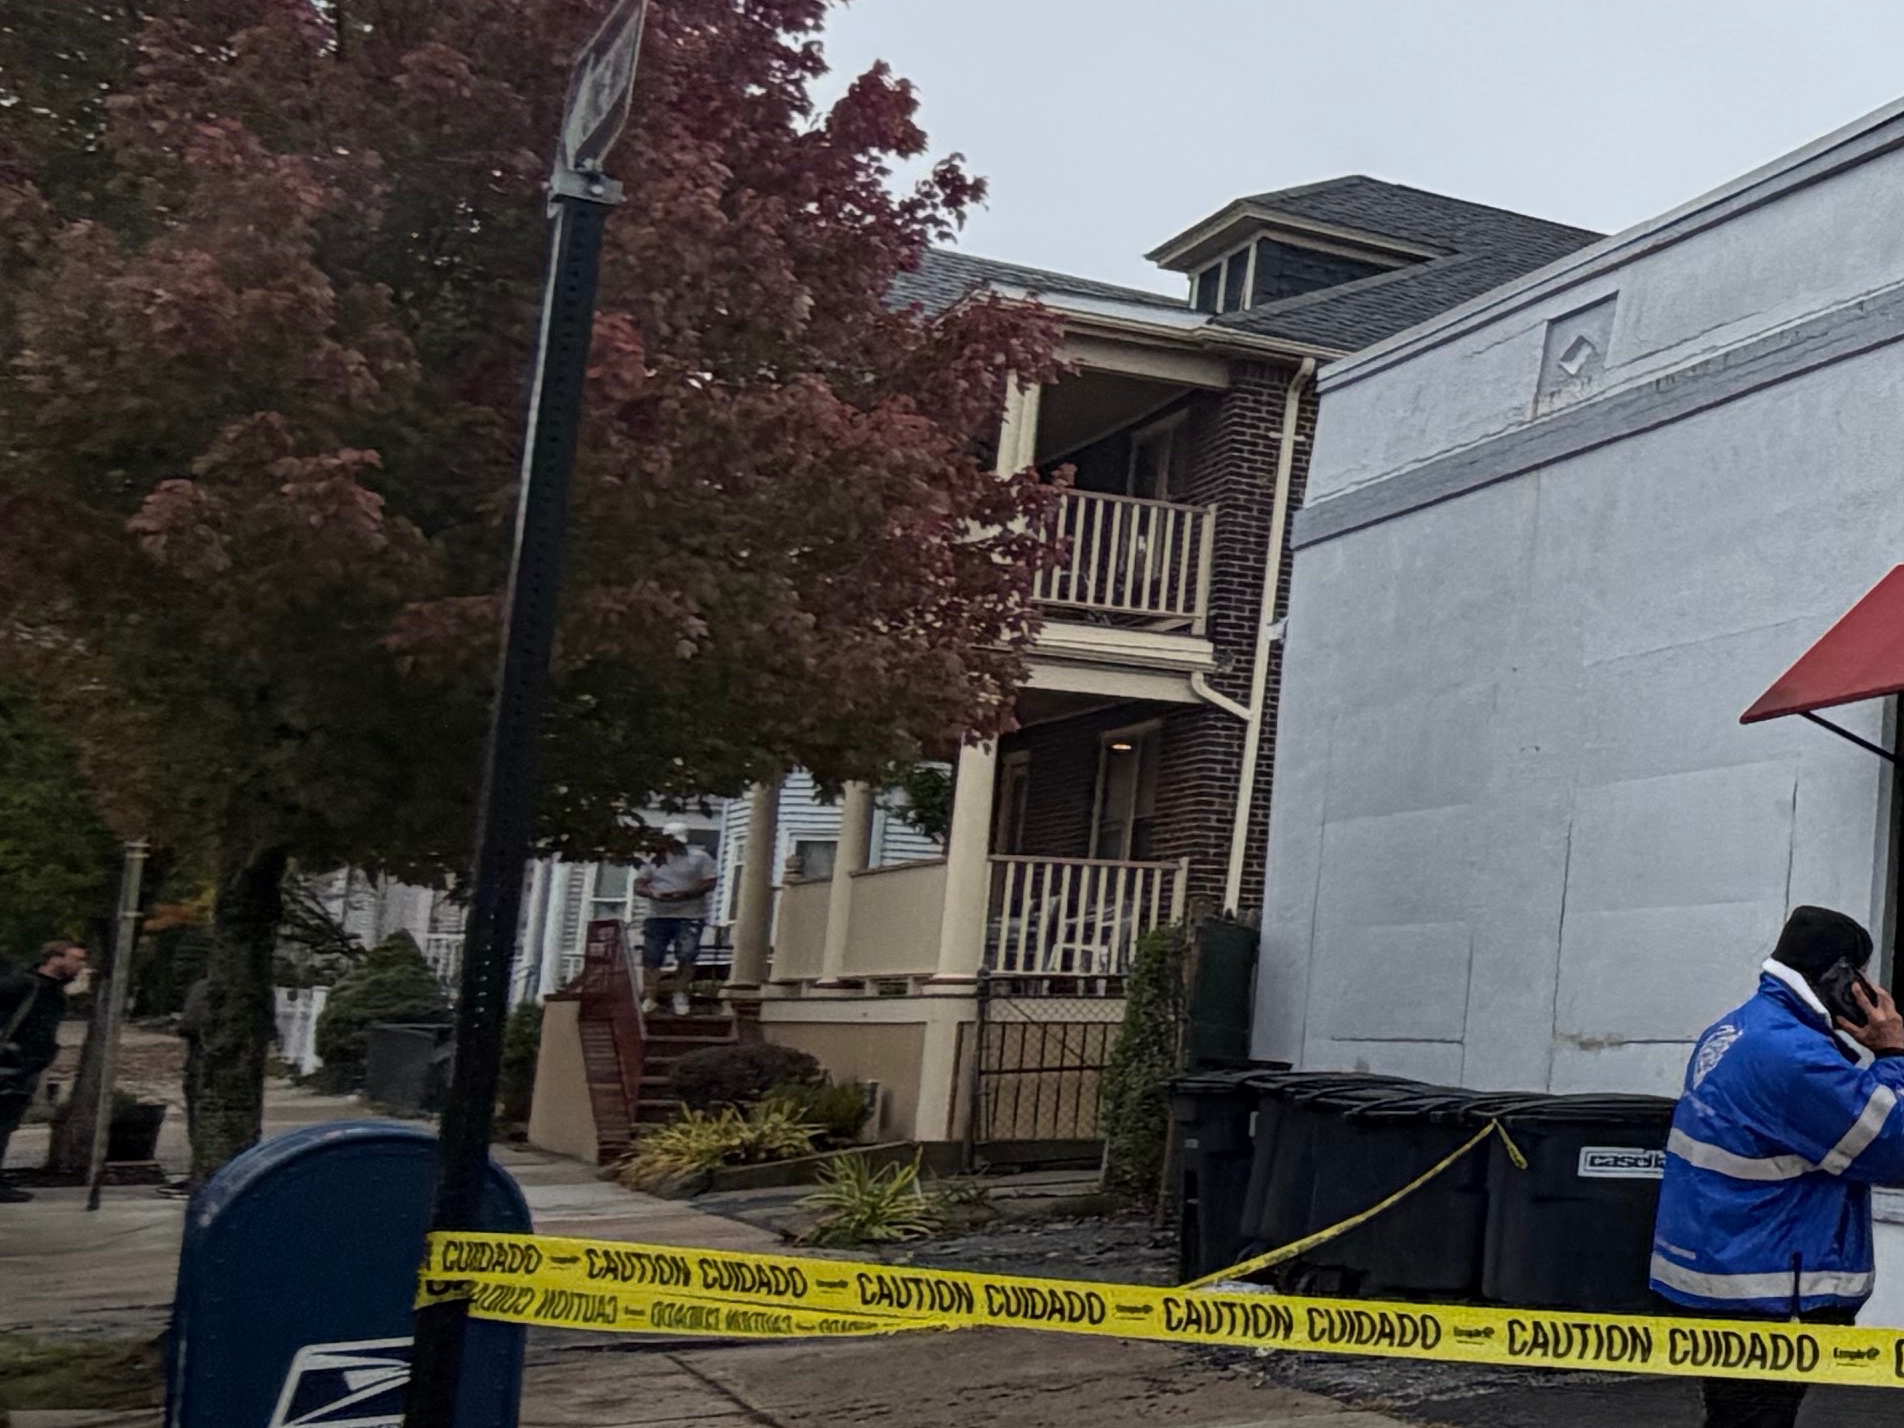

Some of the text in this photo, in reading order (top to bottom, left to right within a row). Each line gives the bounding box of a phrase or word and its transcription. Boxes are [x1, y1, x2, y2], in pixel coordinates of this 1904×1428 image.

[440, 1240, 543, 1275] CUIDADO
[585, 1248, 692, 1287] CAUTION
[698, 1257, 809, 1298] CUIDADO
[857, 1272, 975, 1314] CAUTION
[986, 1283, 1106, 1325] CUIDADO
[1163, 1296, 1295, 1341] CAUTION
[1306, 1306, 1442, 1350] CUIDADO
[1506, 1318, 1653, 1364] CAUTION
[1668, 1328, 1820, 1372] CUIDADO
